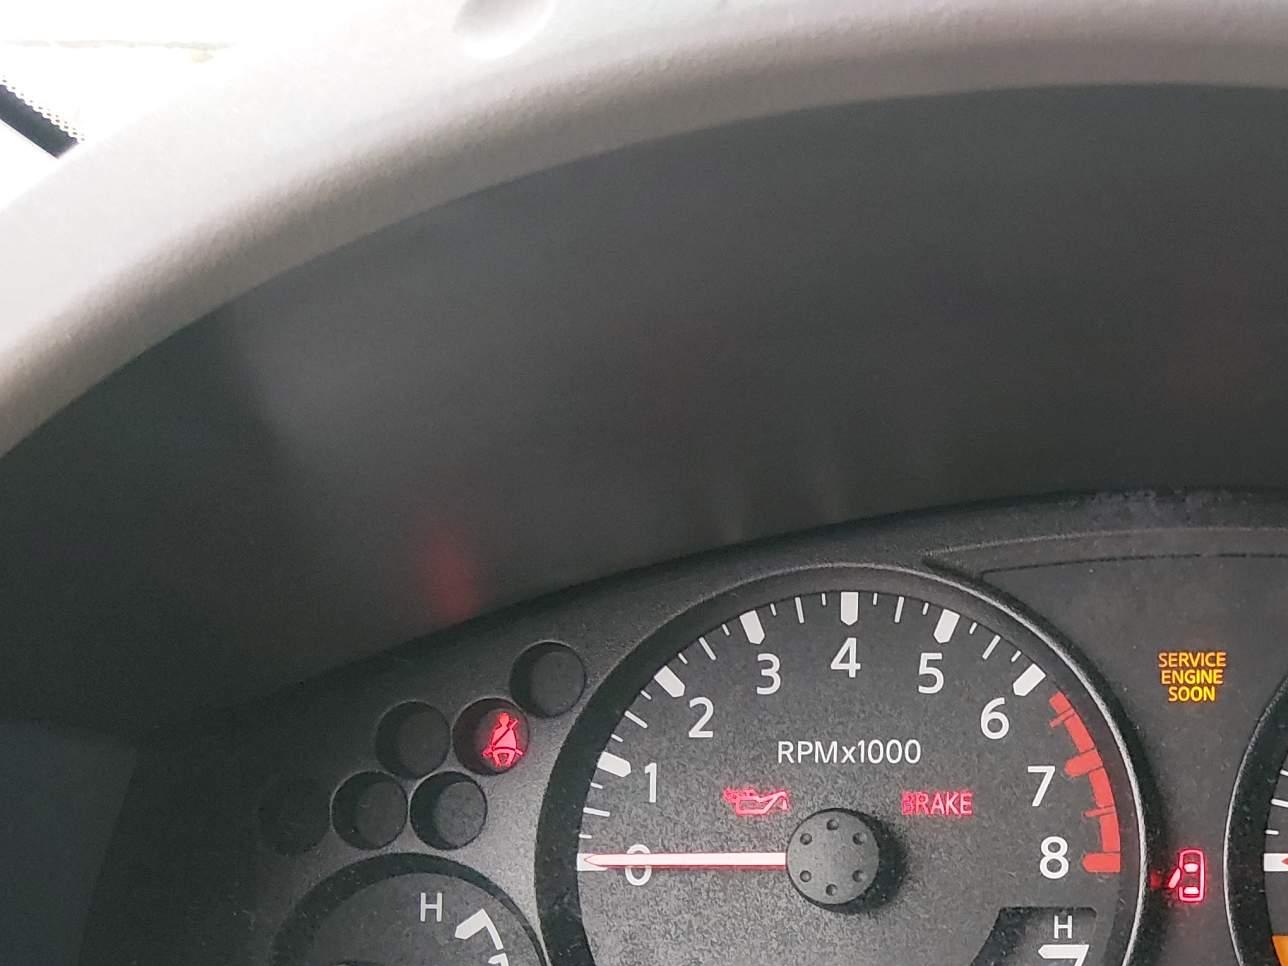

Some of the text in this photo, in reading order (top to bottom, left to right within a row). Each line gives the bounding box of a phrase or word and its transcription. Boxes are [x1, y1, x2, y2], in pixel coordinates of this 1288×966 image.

[756, 653, 781, 695] 3
[830, 637, 861, 678] 4
[918, 652, 944, 694] 5
[1158, 651, 1227, 668] SERVICE
[1161, 668, 1224, 685] ENGINE
[1168, 685, 1216, 702] SOON
[687, 697, 714, 738] 2
[980, 697, 1010, 740] 6
[777, 739, 921, 764] RPMx1000
[644, 762, 657, 803] 1
[901, 790, 973, 816] BRAKE
[1027, 765, 1056, 807] 7
[1039, 836, 1069, 880] 8
[420, 892, 443, 922] H
[1053, 915, 1073, 939] H
